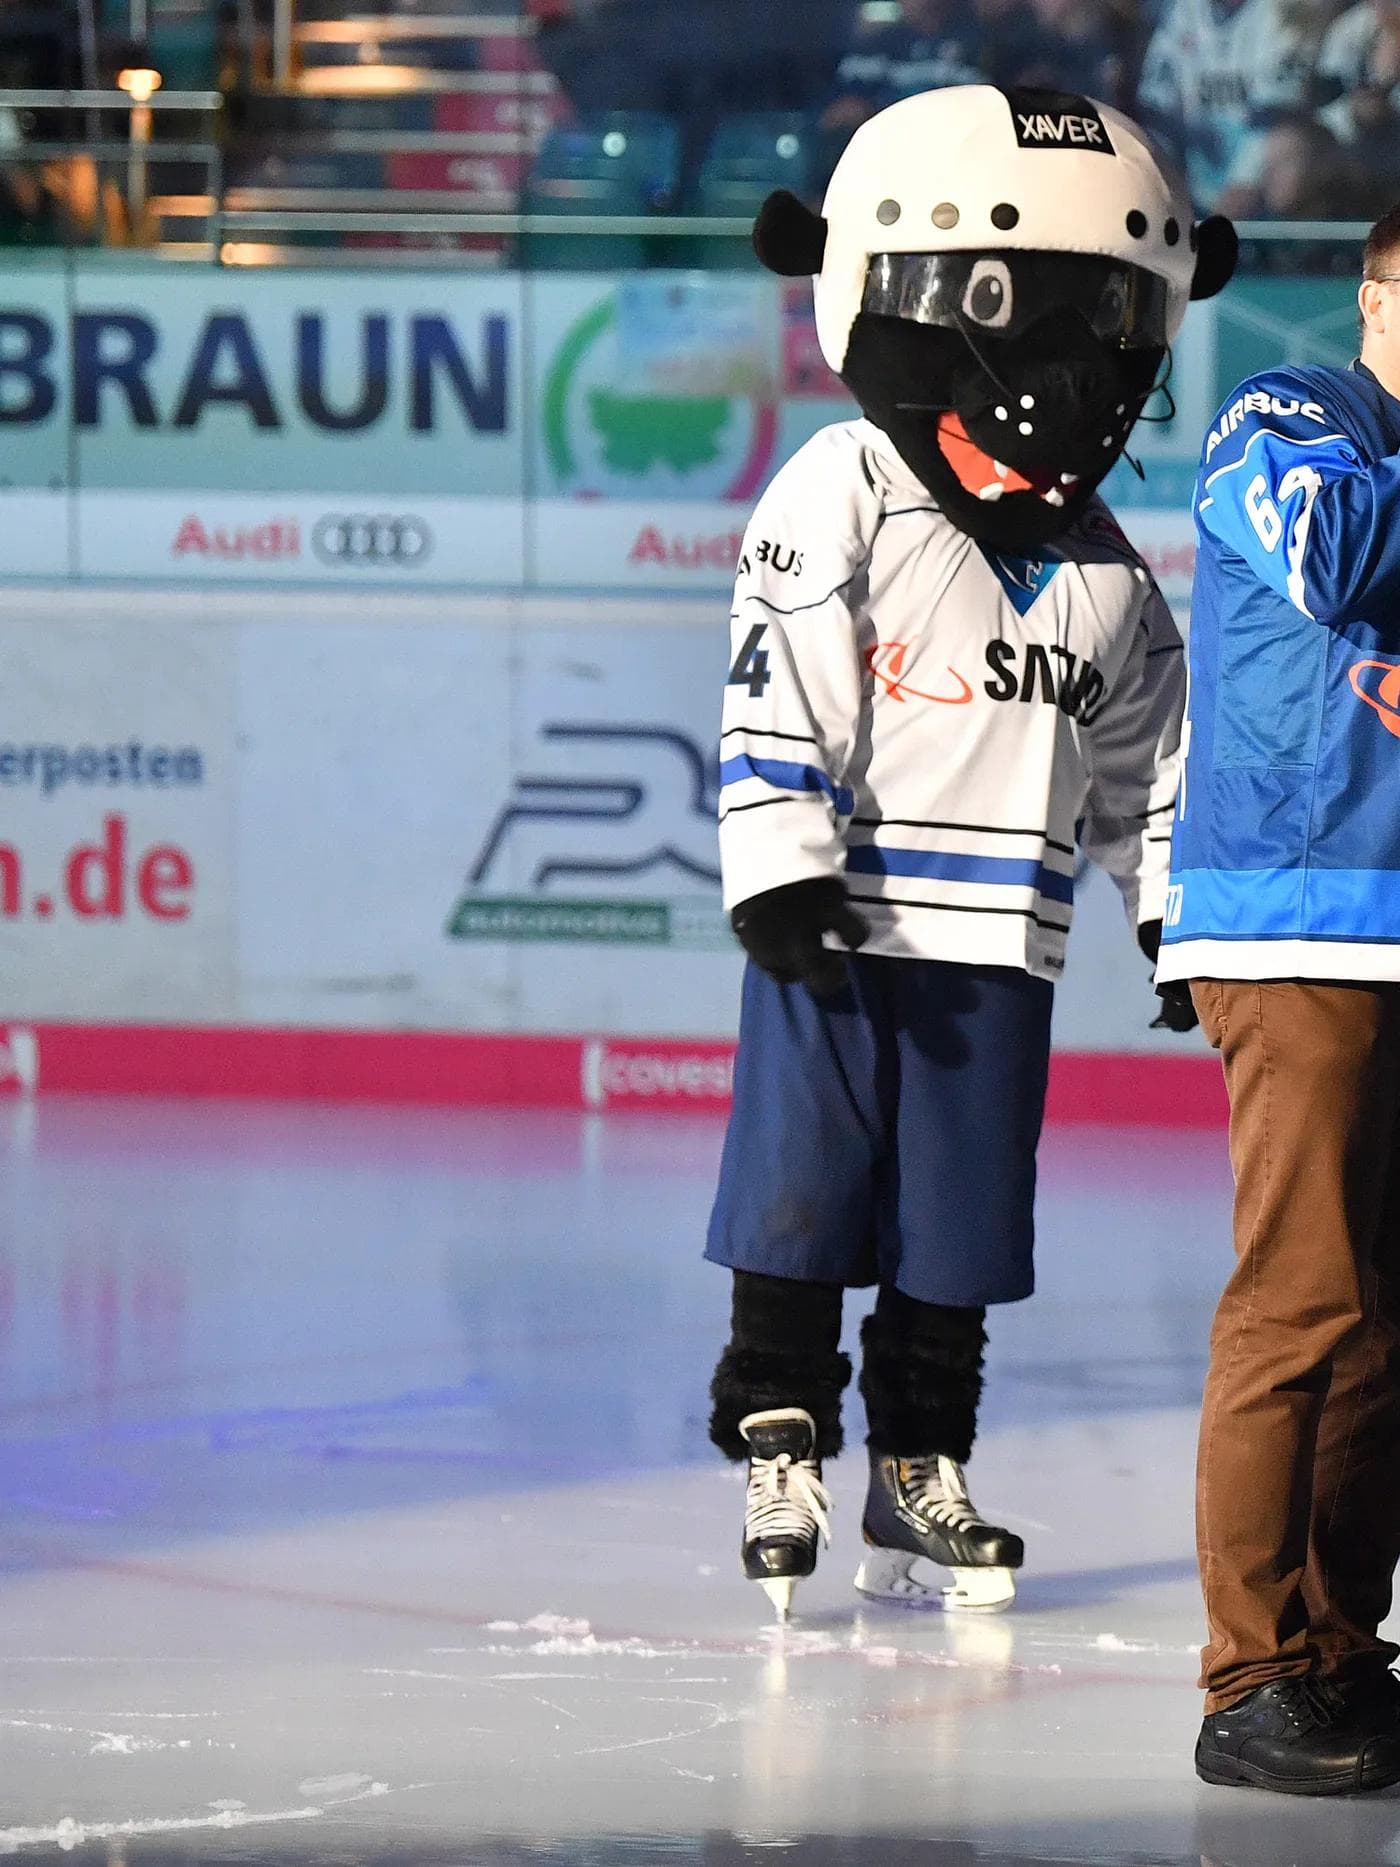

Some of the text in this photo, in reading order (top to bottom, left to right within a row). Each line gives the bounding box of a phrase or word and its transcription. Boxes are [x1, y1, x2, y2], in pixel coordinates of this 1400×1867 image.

[1017, 113, 1103, 144] XAVER
[0, 306, 513, 436] BRAUN
[171, 514, 302, 560] Audi
[626, 522, 743, 570] Aud
